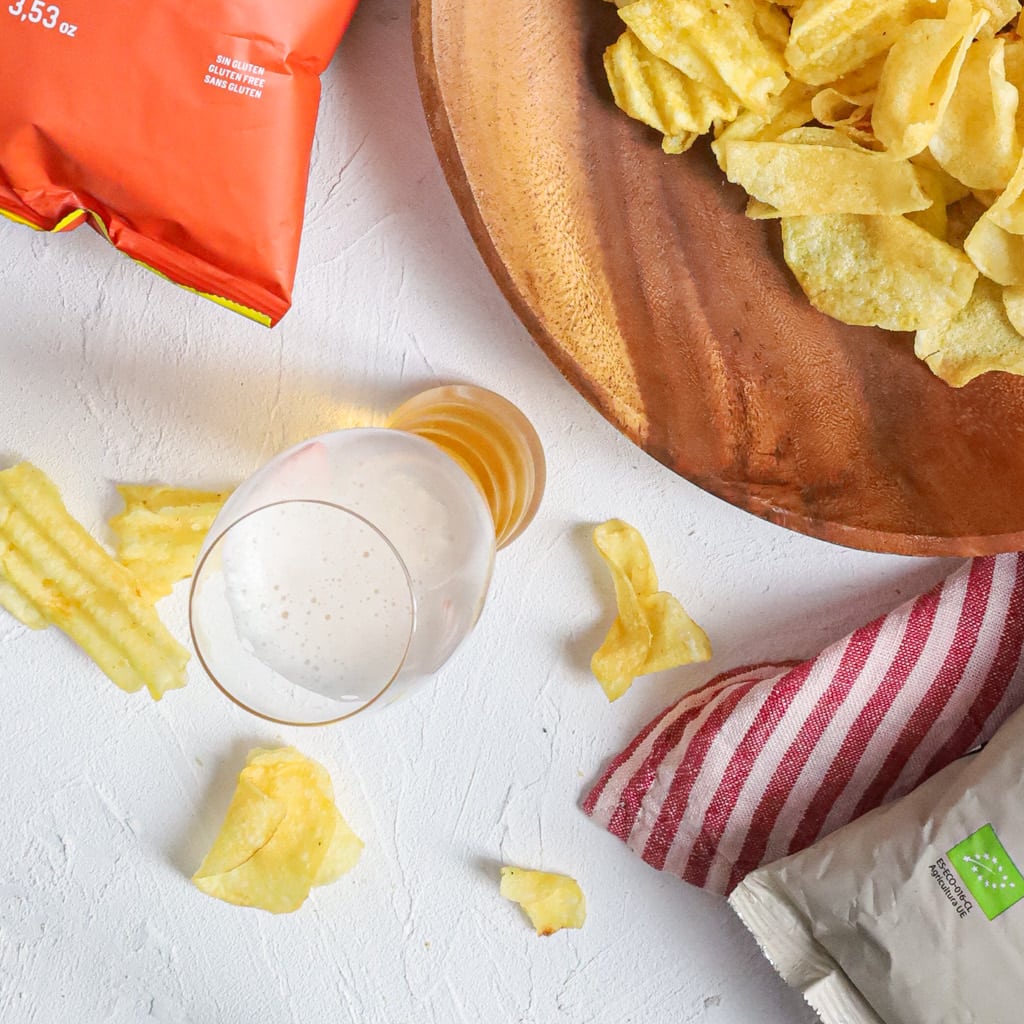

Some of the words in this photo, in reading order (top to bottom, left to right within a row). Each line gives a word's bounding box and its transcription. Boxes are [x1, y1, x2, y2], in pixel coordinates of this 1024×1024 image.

[59, 22, 78, 37] oz
[208, 64, 243, 82] GLUTEN
[242, 74, 266, 88] FREE
[215, 55, 232, 66] SIN
[231, 59, 265, 76] GLUTEN
[204, 74, 228, 89] SANS
[227, 82, 262, 99] GLUTEN
[928, 864, 958, 907] Agricultura
[956, 906, 967, 918] UE
[936, 857, 973, 913] ES-ECO-016-CL
